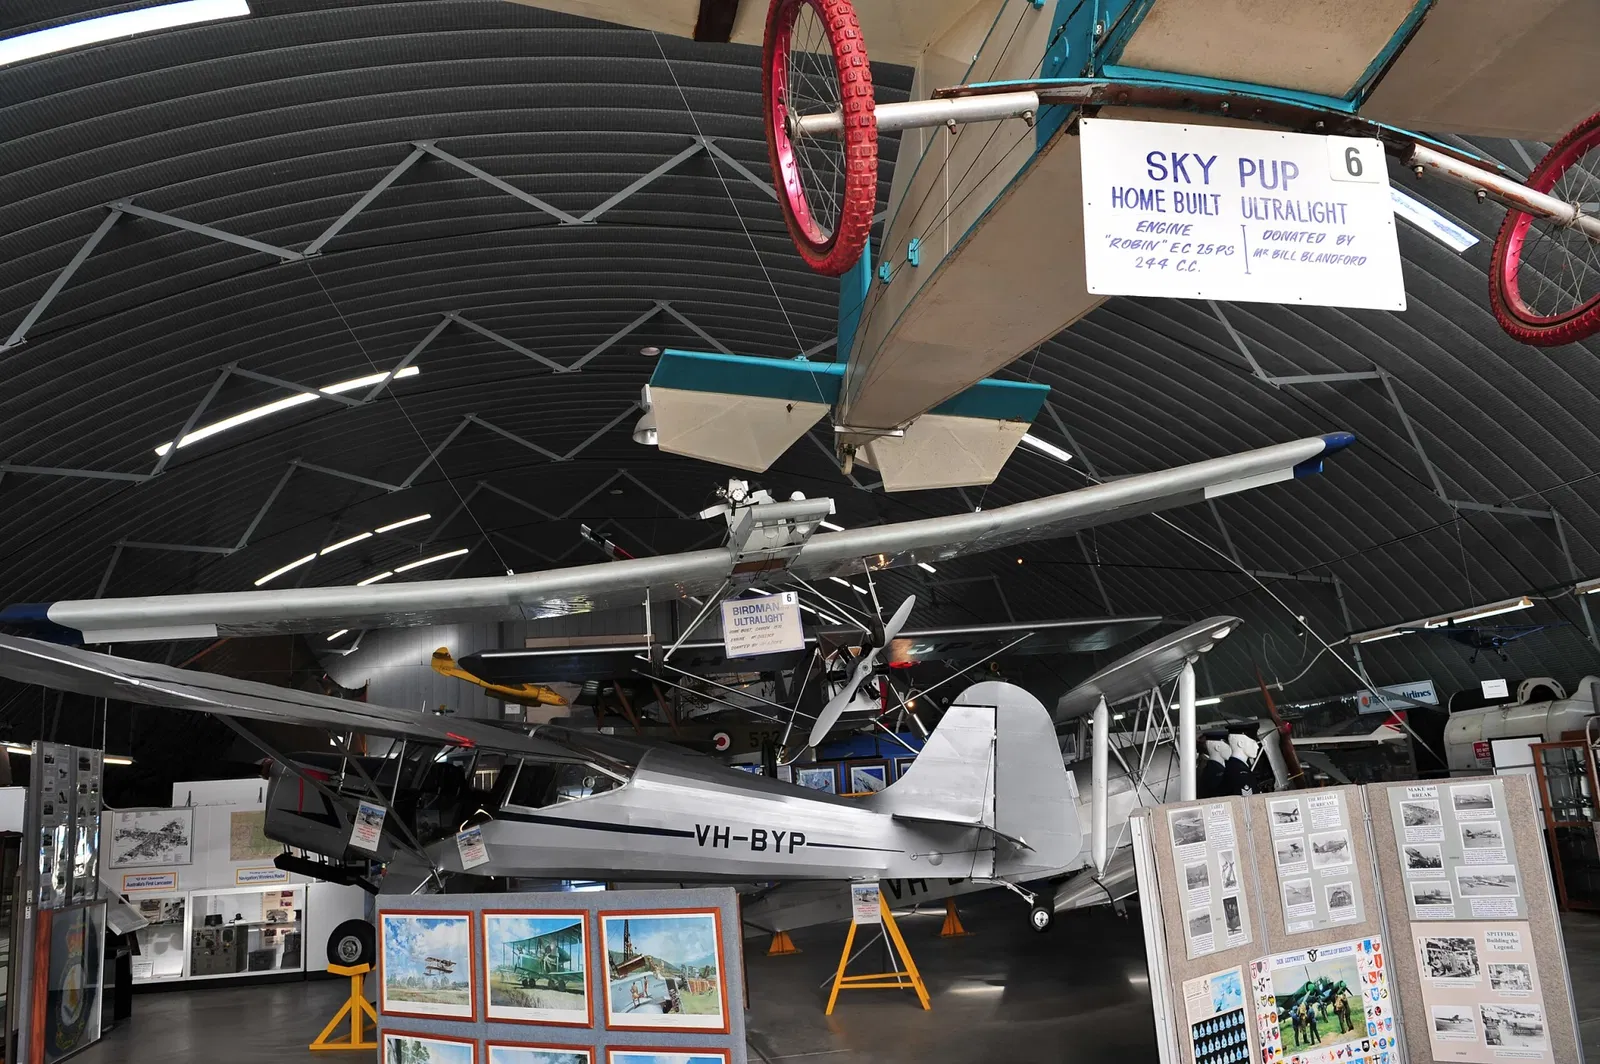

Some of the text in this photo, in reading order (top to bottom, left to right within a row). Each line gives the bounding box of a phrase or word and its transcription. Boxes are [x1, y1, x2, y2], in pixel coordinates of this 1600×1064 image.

[1345, 147, 1363, 176] 6
[1146, 151, 1298, 190] SKY PUP
[1112, 186, 1348, 224] HOME BUILT ULTRALIGHT
[1136, 220, 1193, 236] ENGINE
[1262, 230, 1355, 246] DONATED BY
[1170, 242, 1191, 253] EC
[1136, 256, 1169, 269] 244
[1272, 250, 1296, 260] BILL
[1300, 251, 1367, 266] BLANDFORD
[787, 594, 792, 602] 6
[733, 602, 780, 615] BIRDMAN
[734, 613, 784, 626] ULTRALIGHT
[696, 824, 806, 854] VH-BYP
